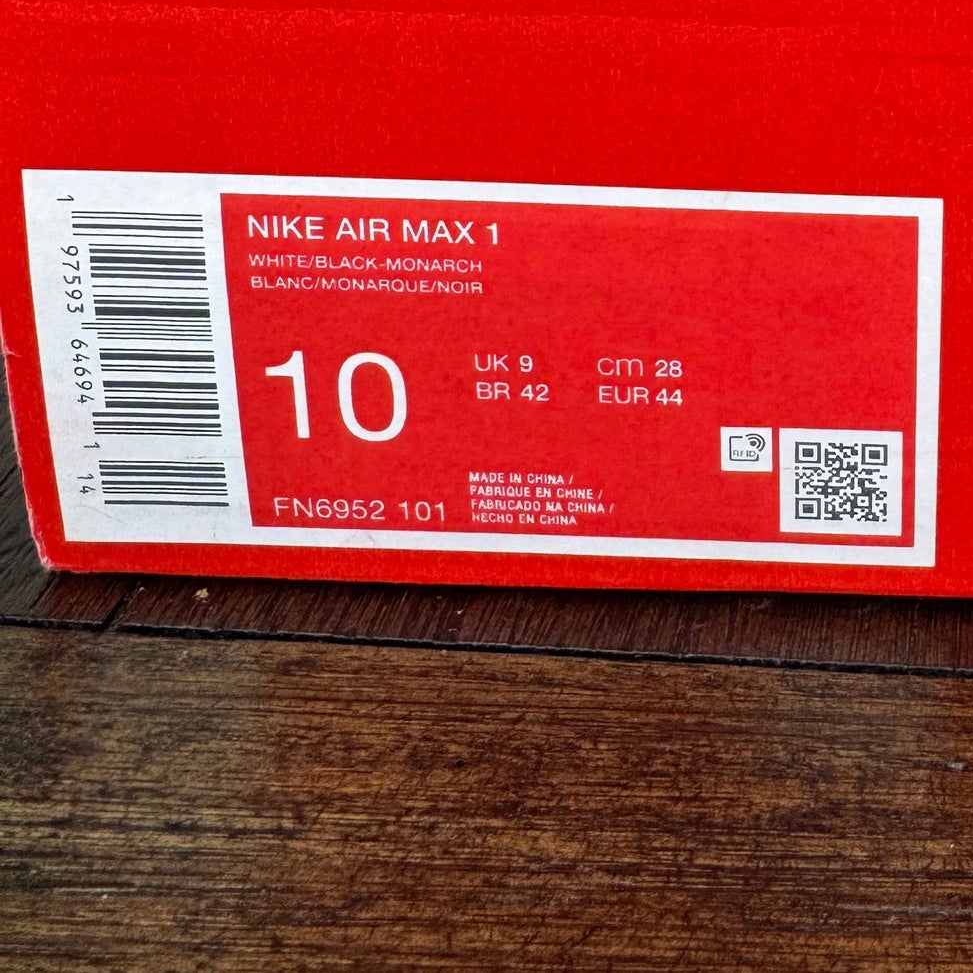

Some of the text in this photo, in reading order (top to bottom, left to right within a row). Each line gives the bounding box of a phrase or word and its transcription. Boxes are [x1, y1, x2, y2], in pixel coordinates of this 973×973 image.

[56, 194, 75, 202] 1
[247, 215, 499, 245] NIKE AIR MAX 1
[248, 254, 483, 274] WHITE/BLACK-MONARCH
[60, 245, 85, 314] 97593
[250, 275, 483, 294] BLANC/MONARQUE/NOIR
[70, 338, 95, 404] 64694
[474, 353, 534, 373] UK 9
[597, 357, 683, 378] cm 28
[265, 350, 408, 442] 10
[476, 381, 550, 402] BR 42
[598, 385, 684, 406] EUR 44
[76, 473, 97, 495] 14
[468, 471, 505, 484] MADE
[509, 473, 522, 484] IN
[527, 473, 565, 485] CHINA
[469, 485, 531, 498] FABRIQUE
[535, 487, 552, 498] EN
[556, 488, 594, 500] CHINE
[273, 497, 445, 522] FN6952 101
[471, 499, 541, 512] FABRICADO
[545, 500, 563, 513] NA
[567, 502, 606, 514] CHINA
[472, 513, 578, 526] HECHO EN CHINA
